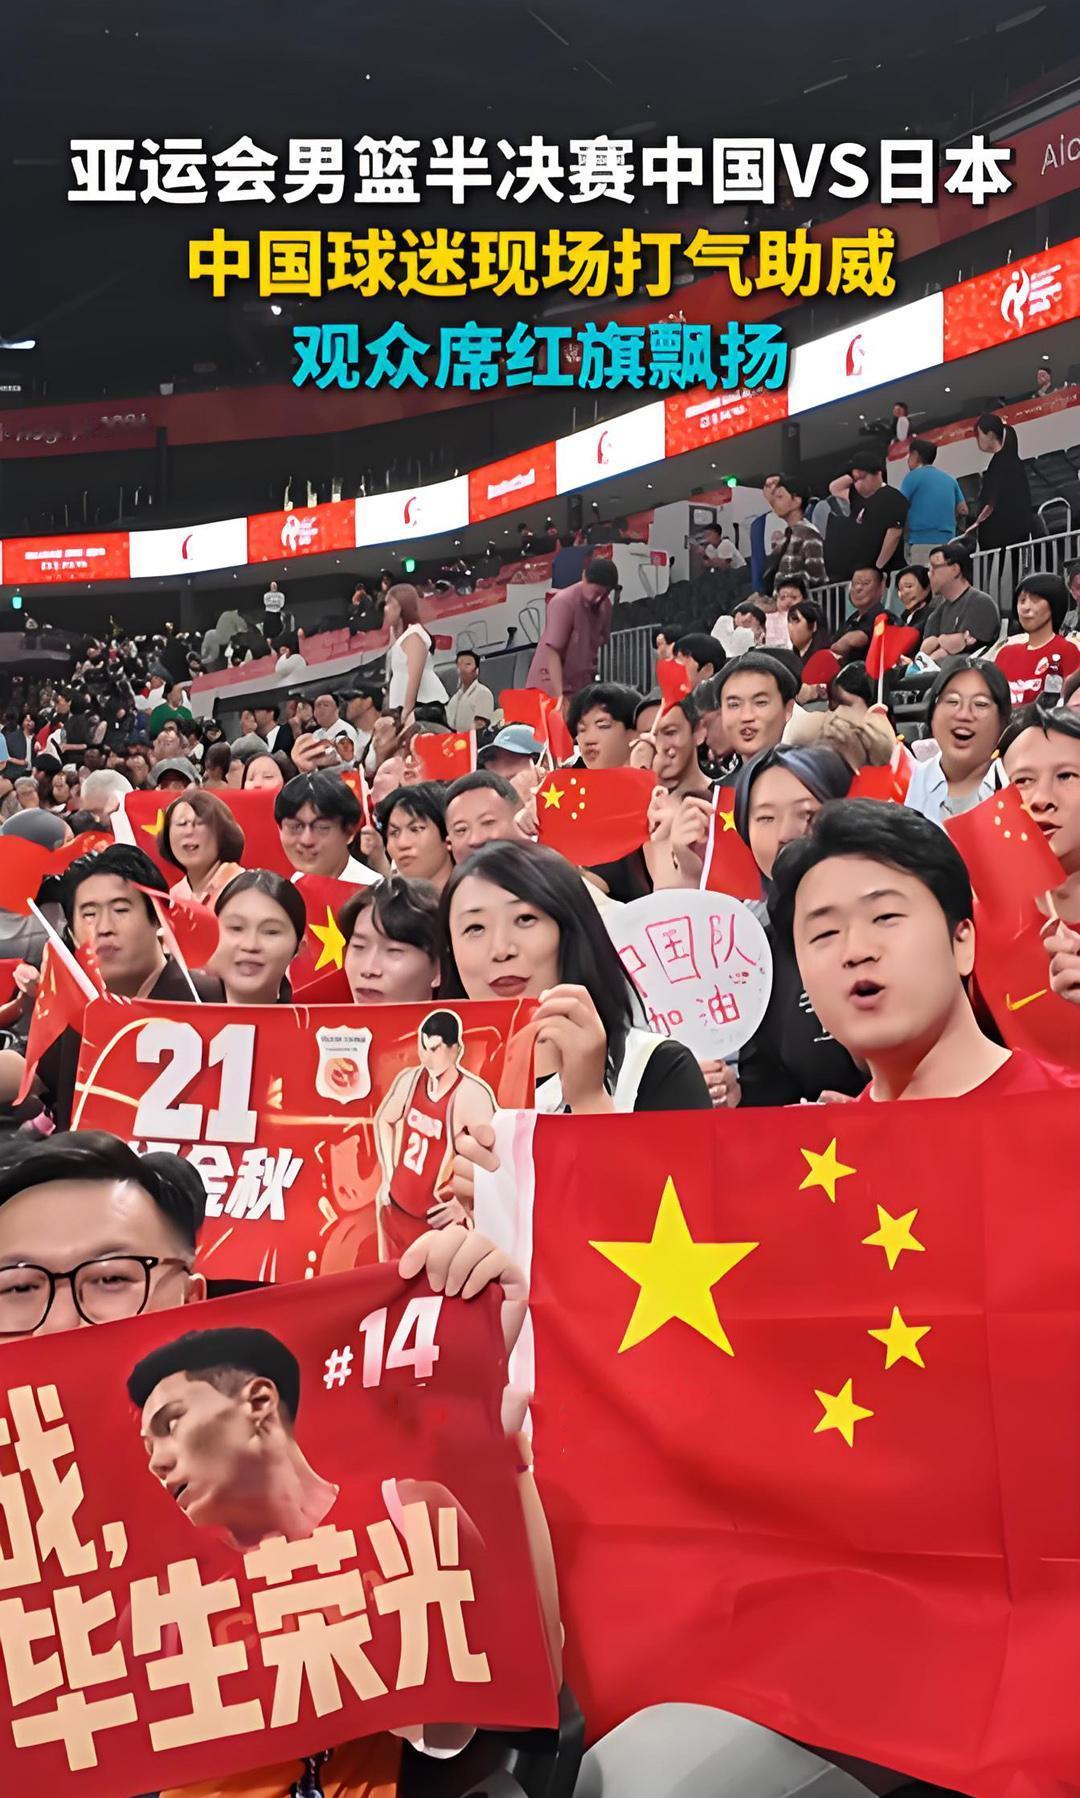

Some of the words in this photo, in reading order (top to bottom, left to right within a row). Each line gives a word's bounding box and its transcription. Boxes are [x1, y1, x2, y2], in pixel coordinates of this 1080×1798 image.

[133, 1022, 257, 1143] 21
[128, 1140, 303, 1220] 金秋
[403, 1131, 428, 1176] 21
[323, 1296, 443, 1389] #14
[0, 1501, 491, 1771] 毕生荣光
